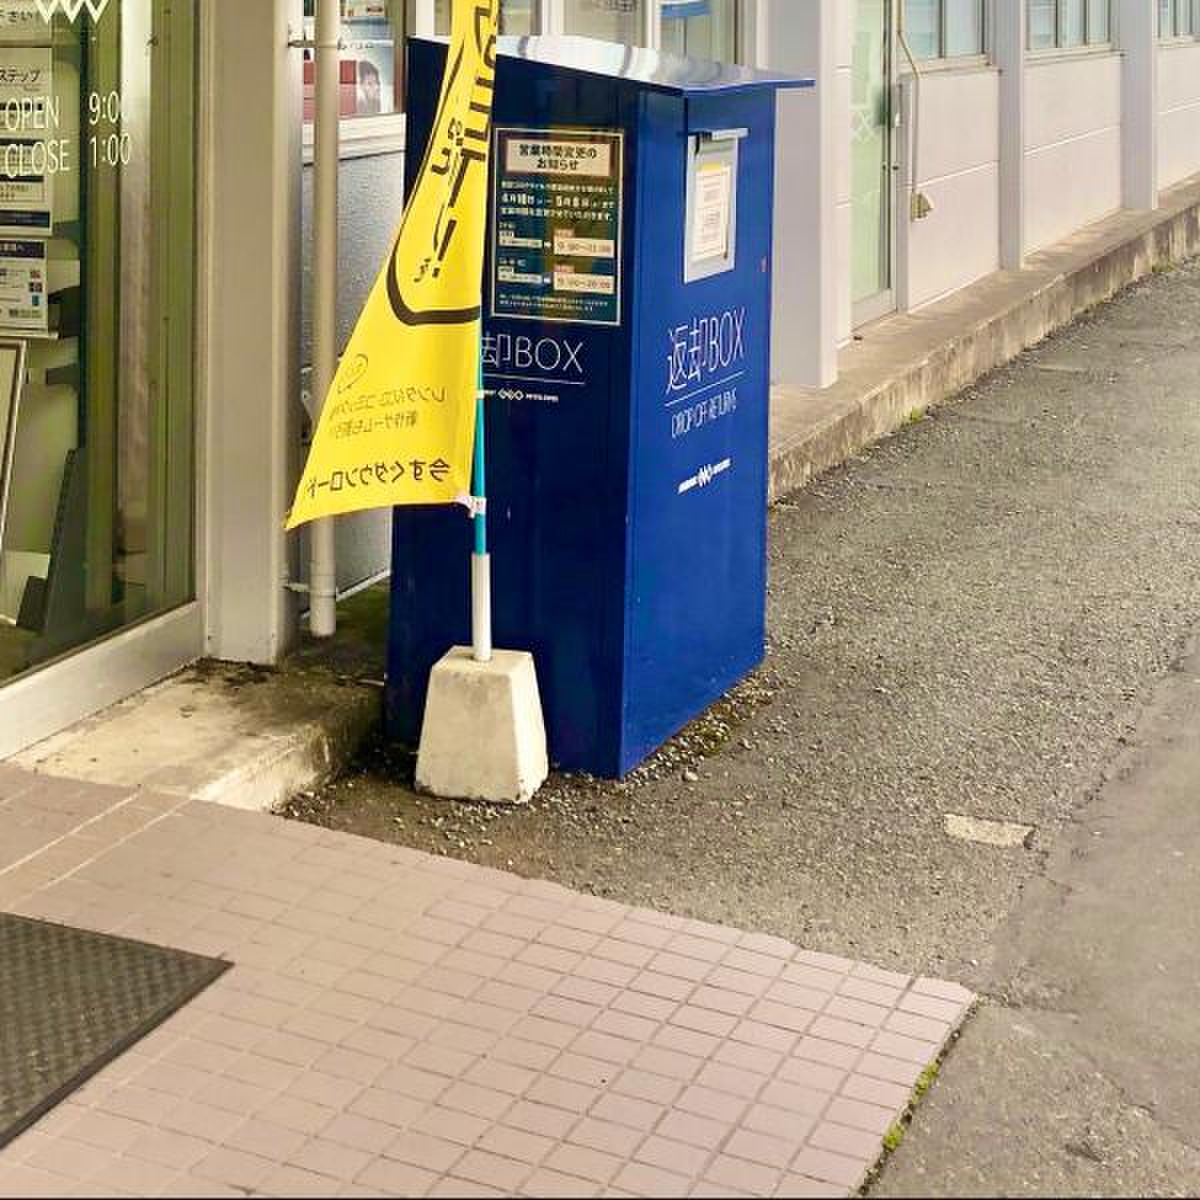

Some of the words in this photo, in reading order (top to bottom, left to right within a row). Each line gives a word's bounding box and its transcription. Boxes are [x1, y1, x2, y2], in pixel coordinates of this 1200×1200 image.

[4, 95, 60, 131] OPEN
[88, 90, 123, 126] 9:0
[4, 139, 71, 179] CLOSE
[89, 132, 132, 168] 1:00
[480, 332, 584, 374] 却BOX
[666, 306, 745, 395] 返却BOX
